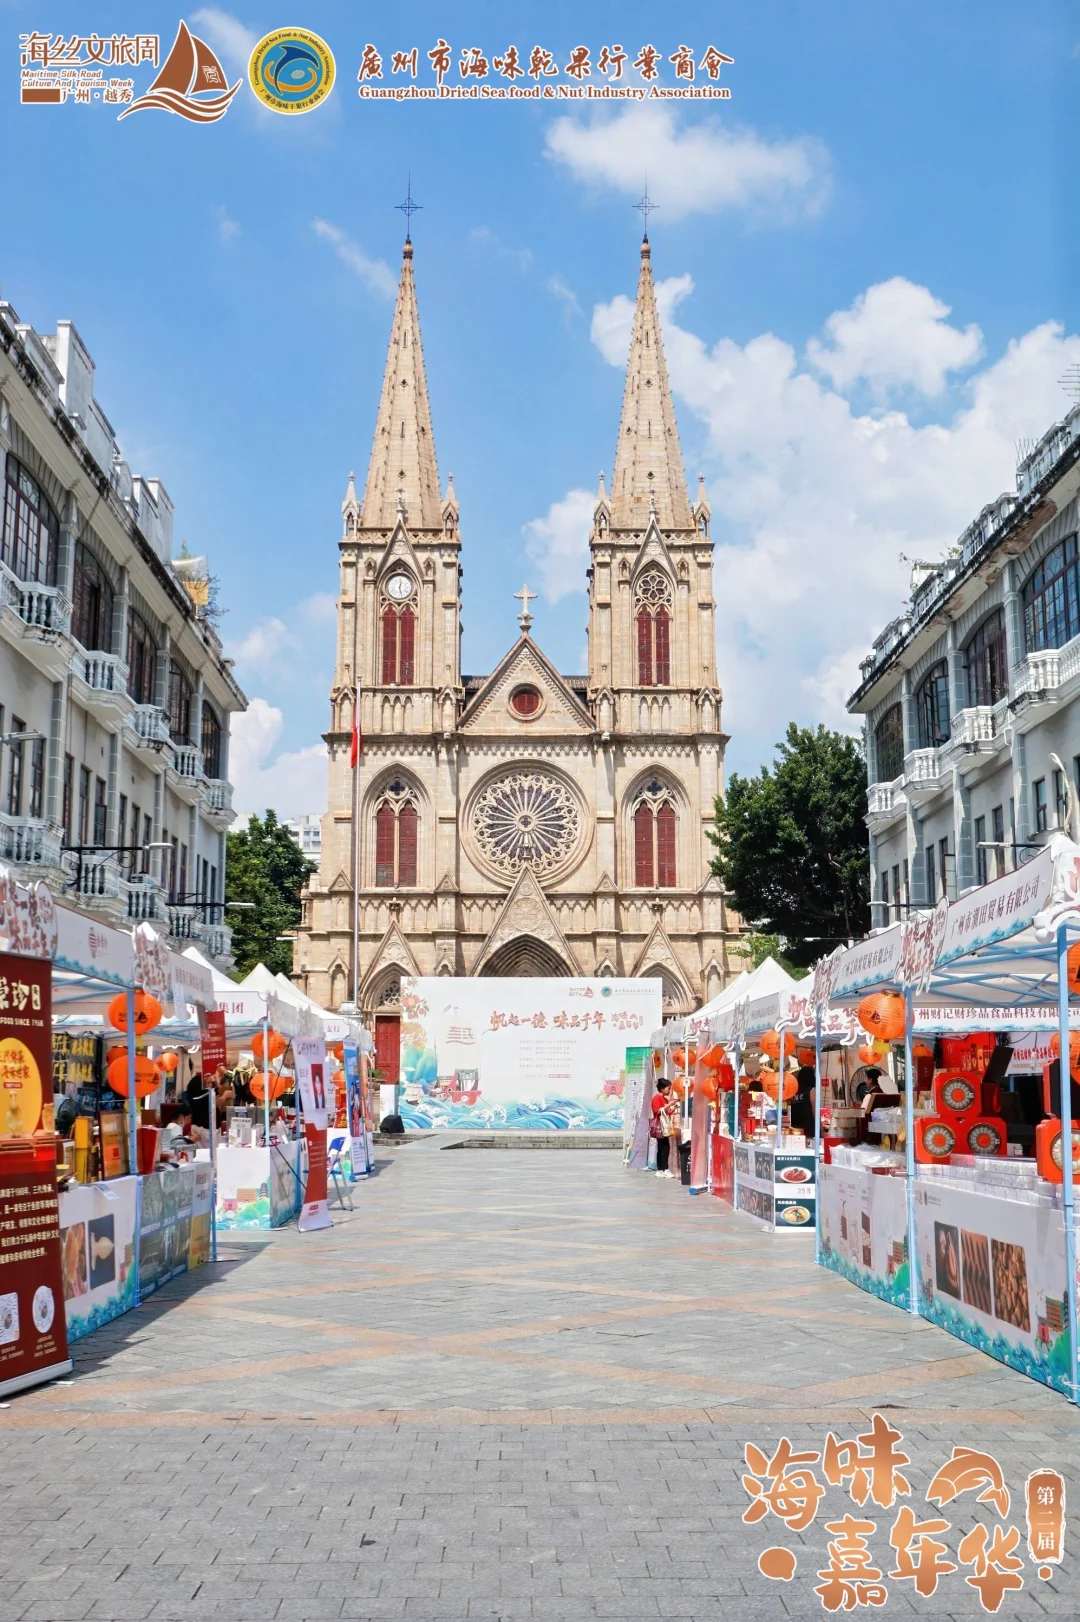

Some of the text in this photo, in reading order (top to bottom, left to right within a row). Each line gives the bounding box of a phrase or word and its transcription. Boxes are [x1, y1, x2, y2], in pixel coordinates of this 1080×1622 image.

[15, 1018, 31, 1026] SINCE
[482, 1010, 607, 1036] 帆起一德 味品千年
